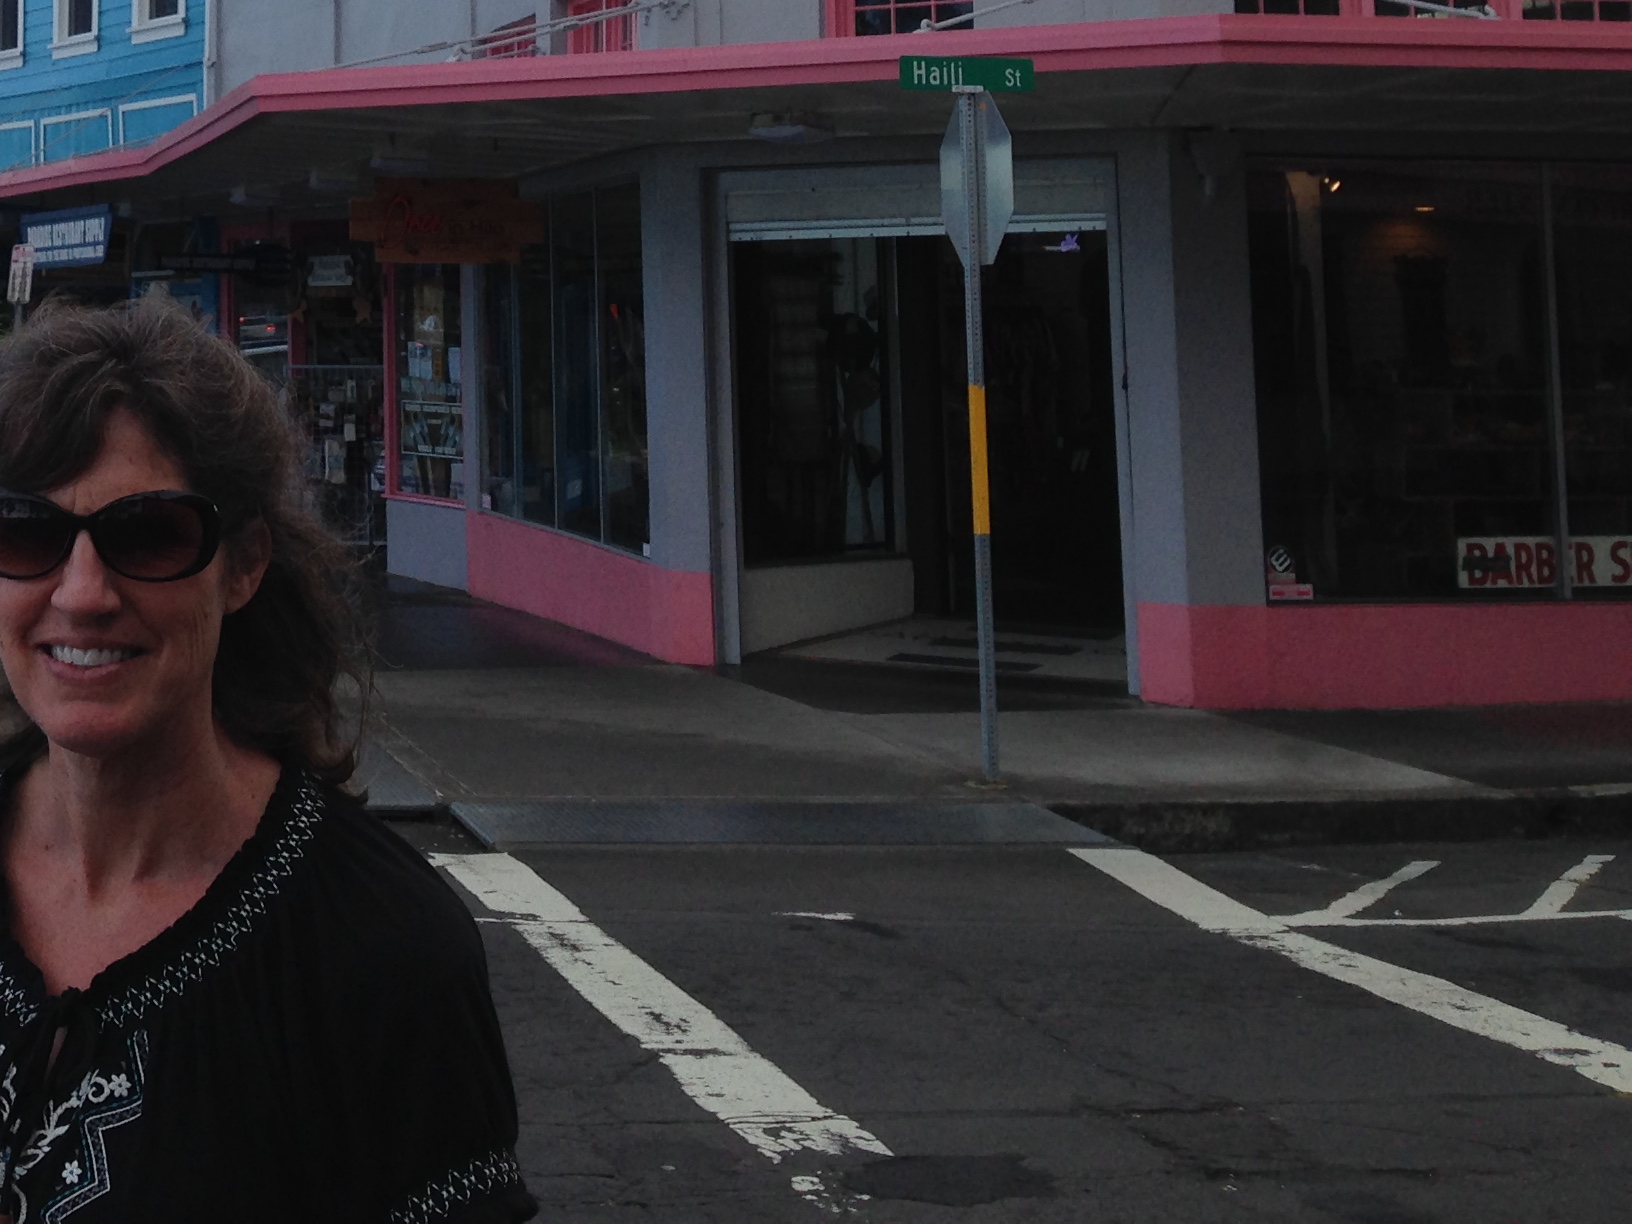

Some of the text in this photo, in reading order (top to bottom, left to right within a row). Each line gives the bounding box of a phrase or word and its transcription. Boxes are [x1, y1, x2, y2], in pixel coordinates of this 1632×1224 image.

[913, 61, 1022, 88] Haili St
[1465, 540, 1632, 587] BARBR S
